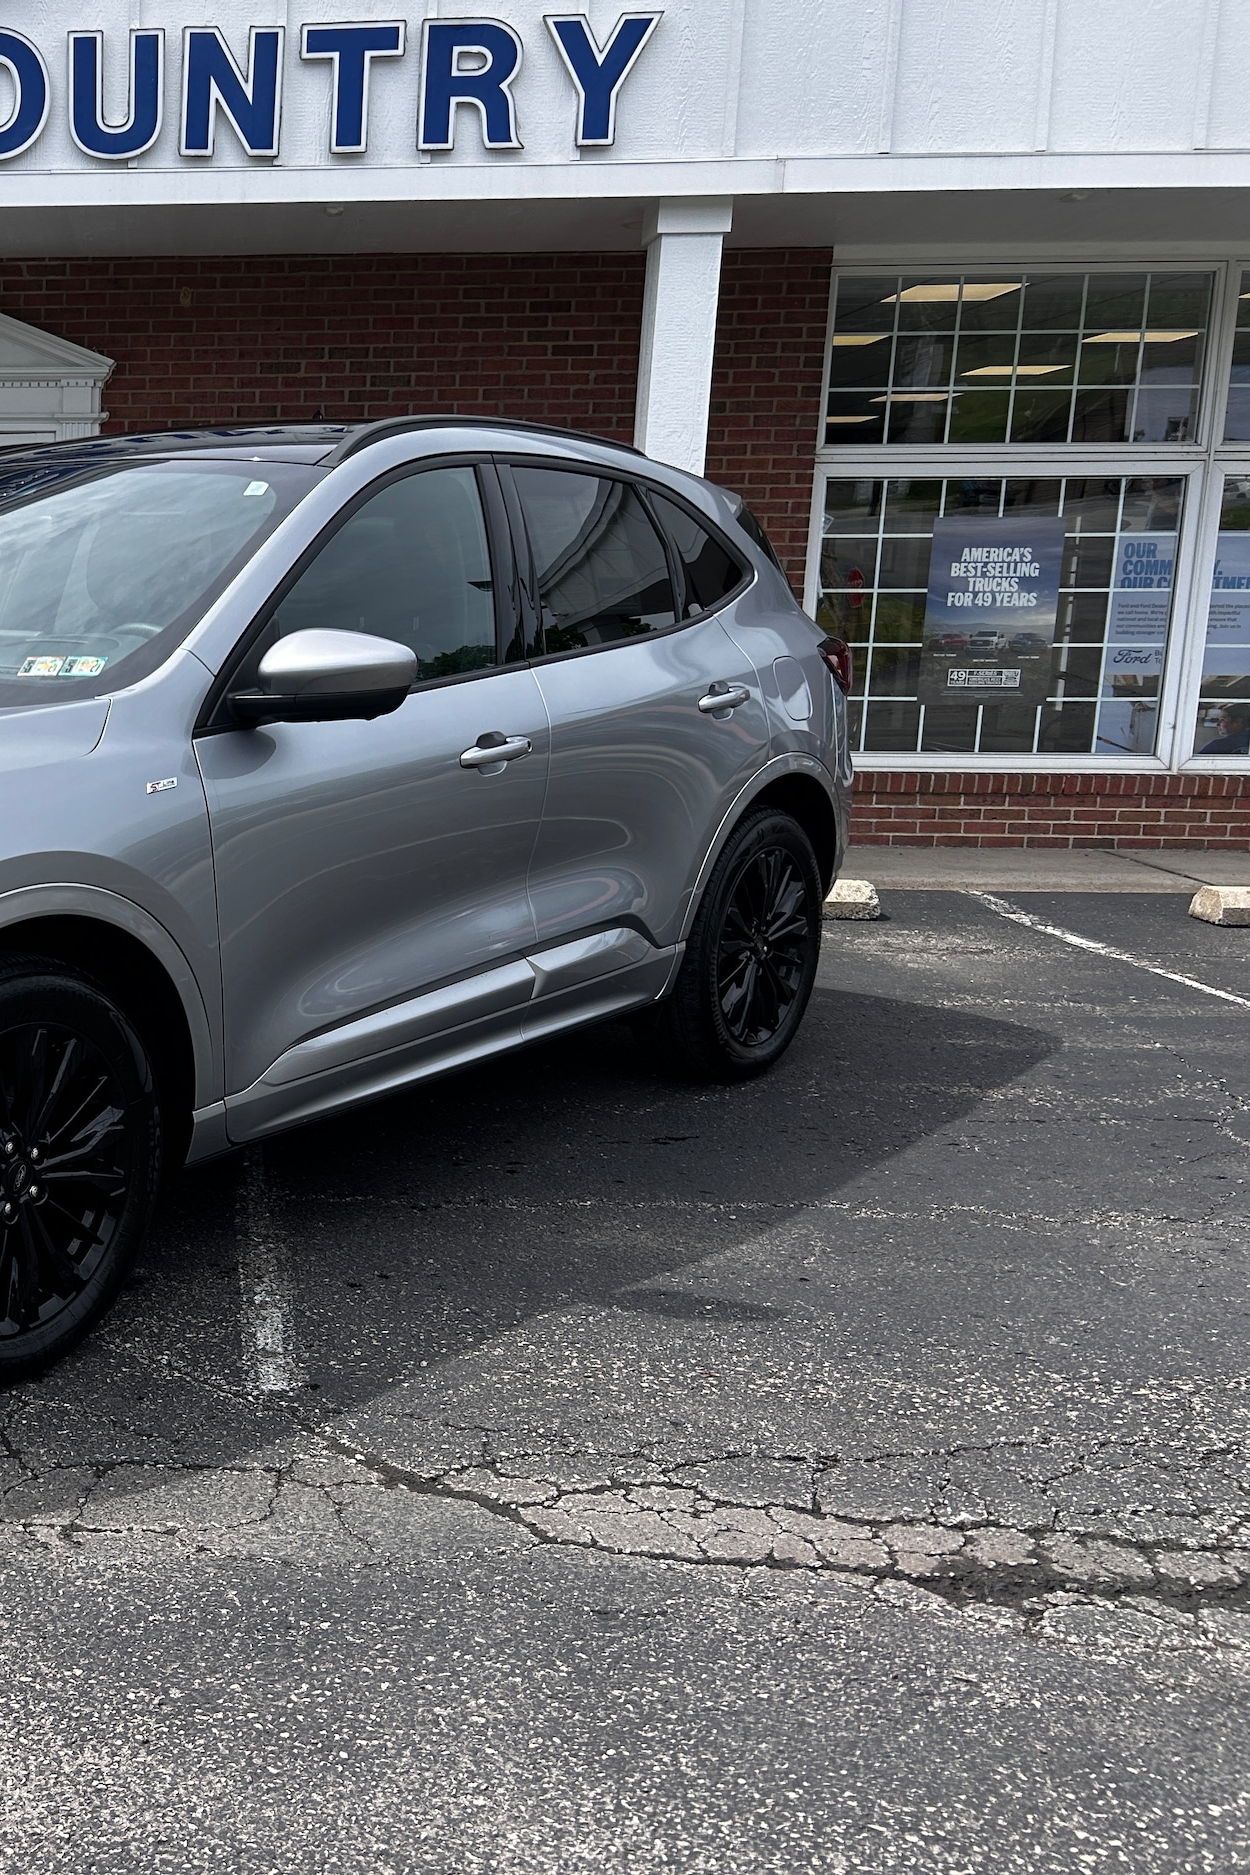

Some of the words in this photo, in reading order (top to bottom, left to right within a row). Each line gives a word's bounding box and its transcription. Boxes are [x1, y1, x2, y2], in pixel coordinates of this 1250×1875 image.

[961, 547, 1032, 562] AMERICA'S
[1124, 543, 1157, 559] OUR
[951, 562, 1040, 577] BEST-SELLING
[968, 577, 1019, 592] TRUCKS
[947, 592, 972, 607] FOR
[975, 592, 992, 607] 49
[995, 592, 1038, 607] YEARS
[1113, 649, 1153, 664] Ford
[950, 671, 966, 681] 49
